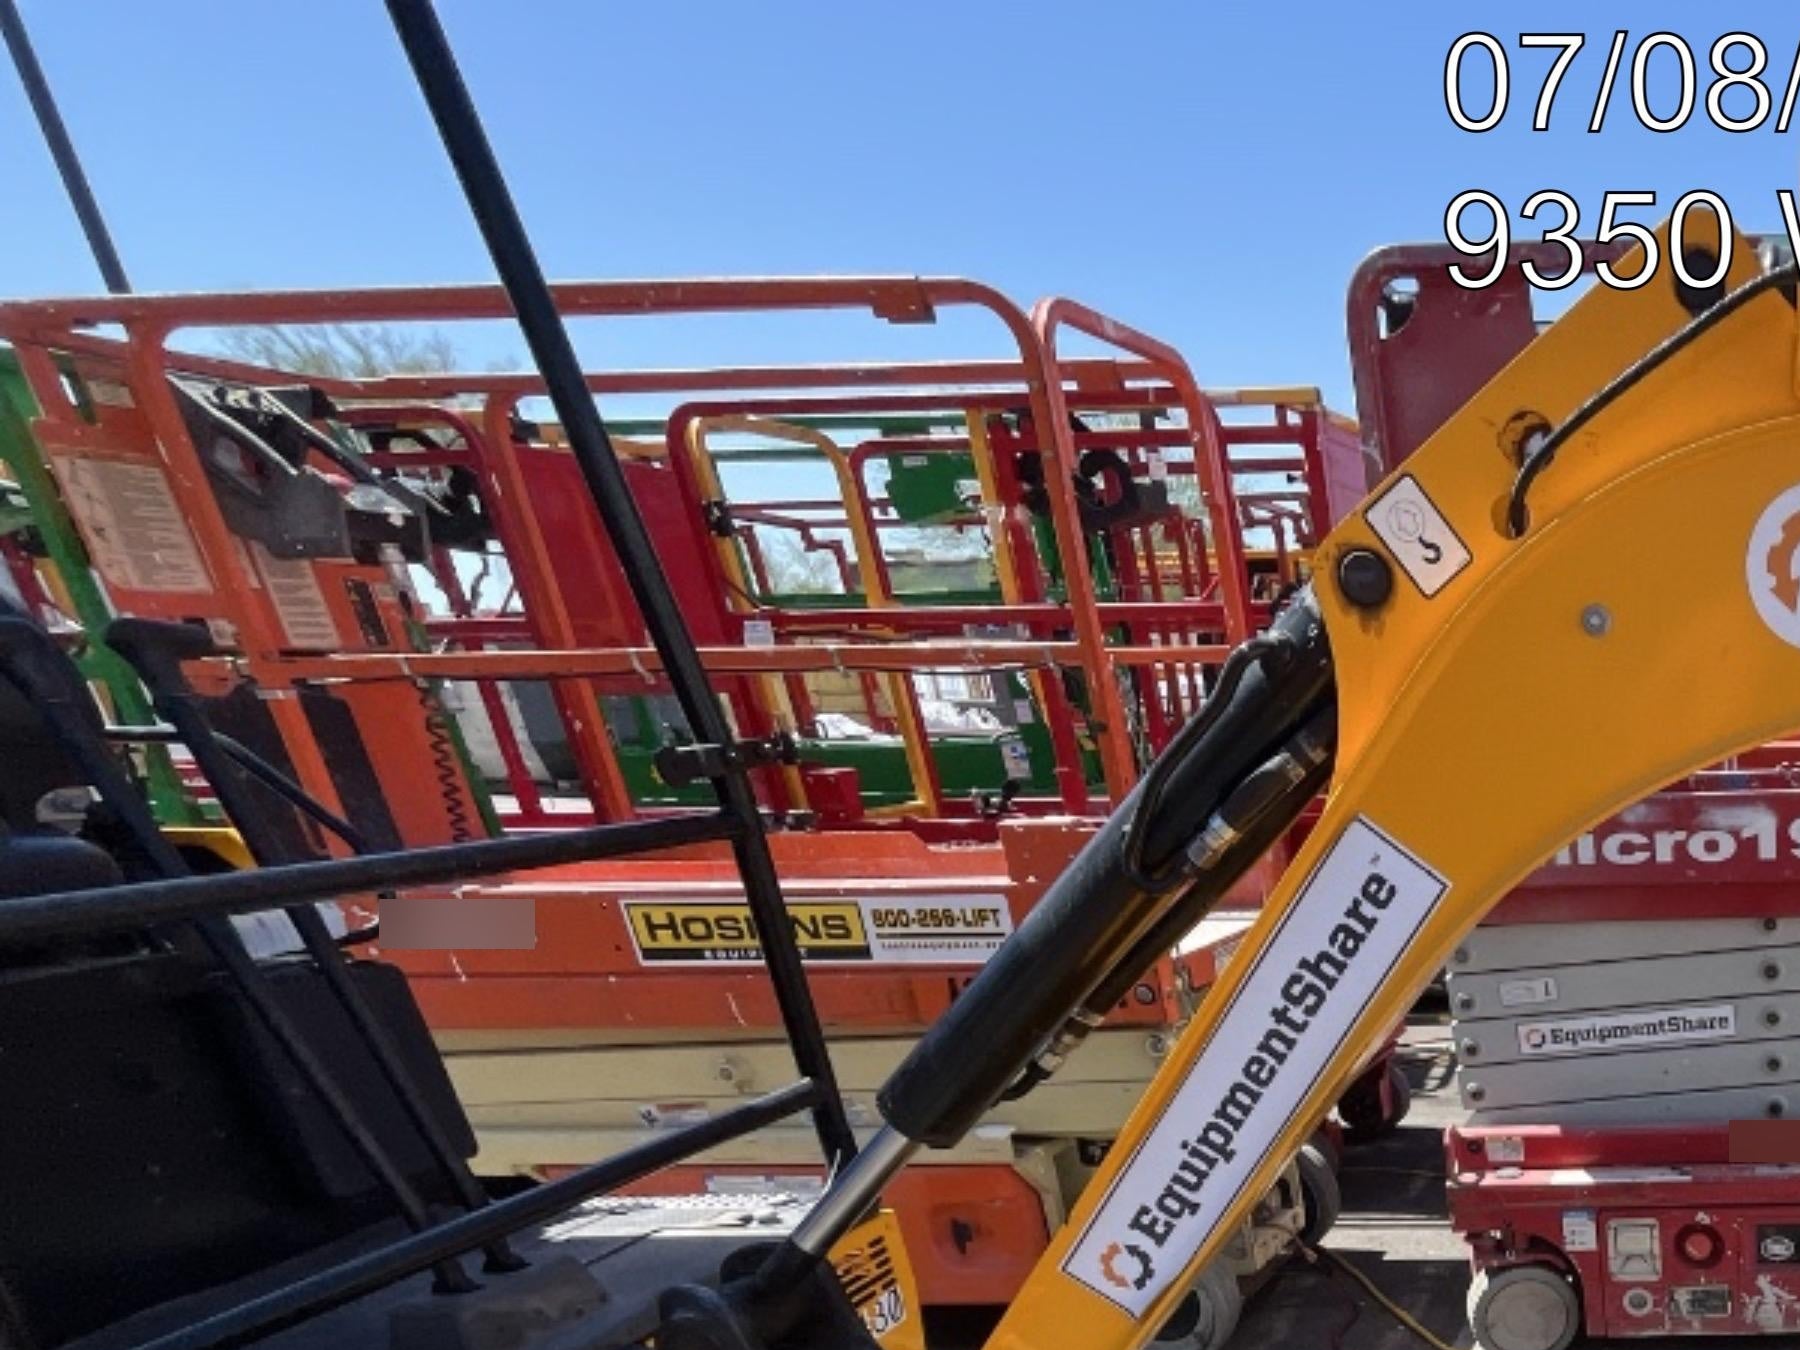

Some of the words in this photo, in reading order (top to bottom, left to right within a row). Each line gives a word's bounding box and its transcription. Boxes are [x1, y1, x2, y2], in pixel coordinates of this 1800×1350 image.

[642, 910, 853, 943] HOSNS
[1549, 1014, 1730, 1046] EquipmentShare
[1127, 871, 1397, 1249] EquipmentShare
